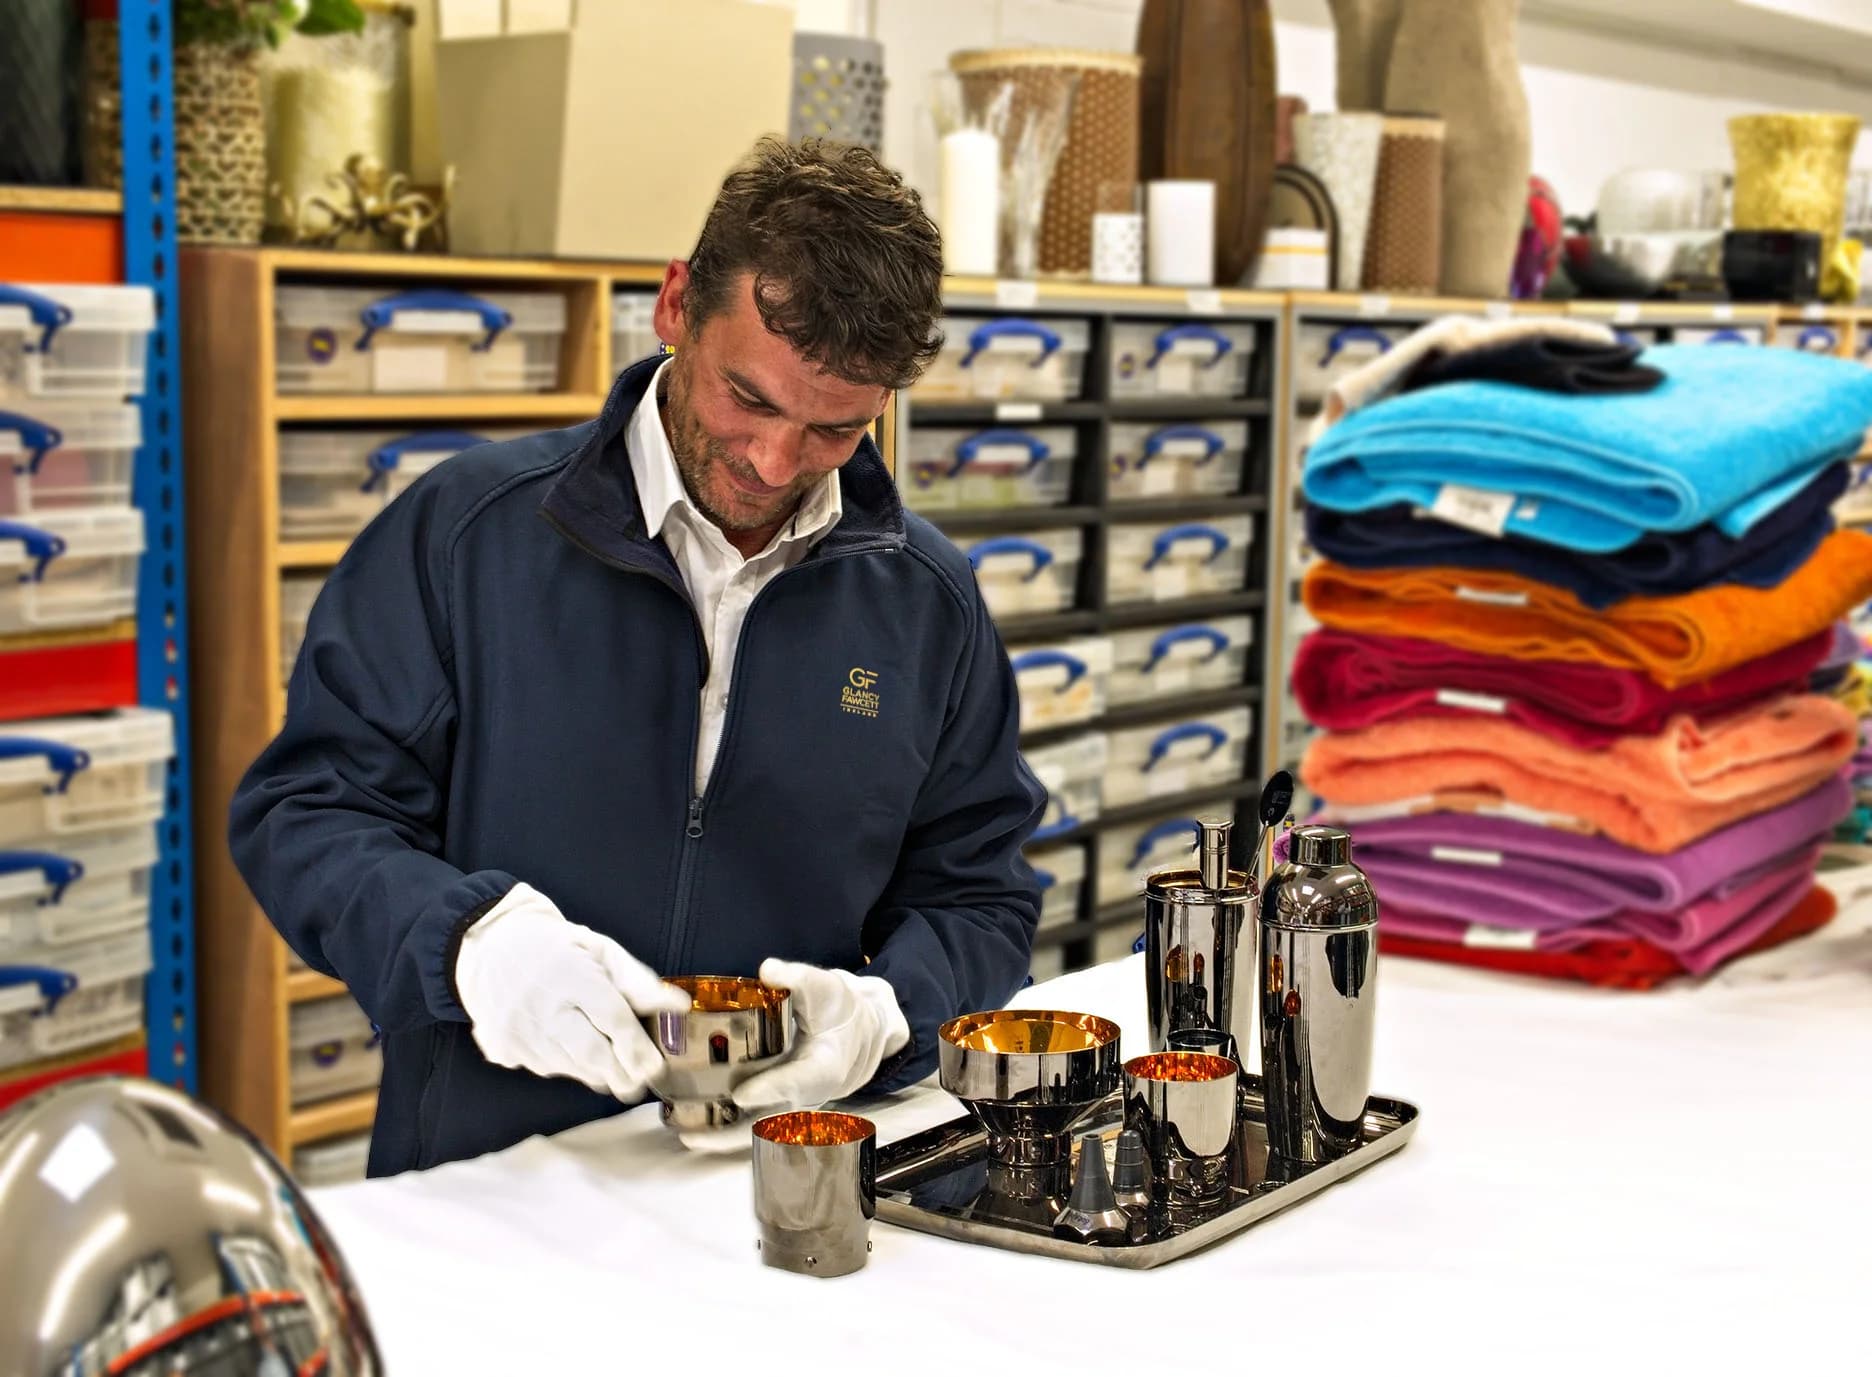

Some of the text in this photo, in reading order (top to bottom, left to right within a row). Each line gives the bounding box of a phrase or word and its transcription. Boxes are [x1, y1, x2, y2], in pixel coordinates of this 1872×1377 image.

[849, 667, 879, 689] GF
[842, 686, 880, 701] GLANCY
[841, 695, 879, 709] FAWCETT
